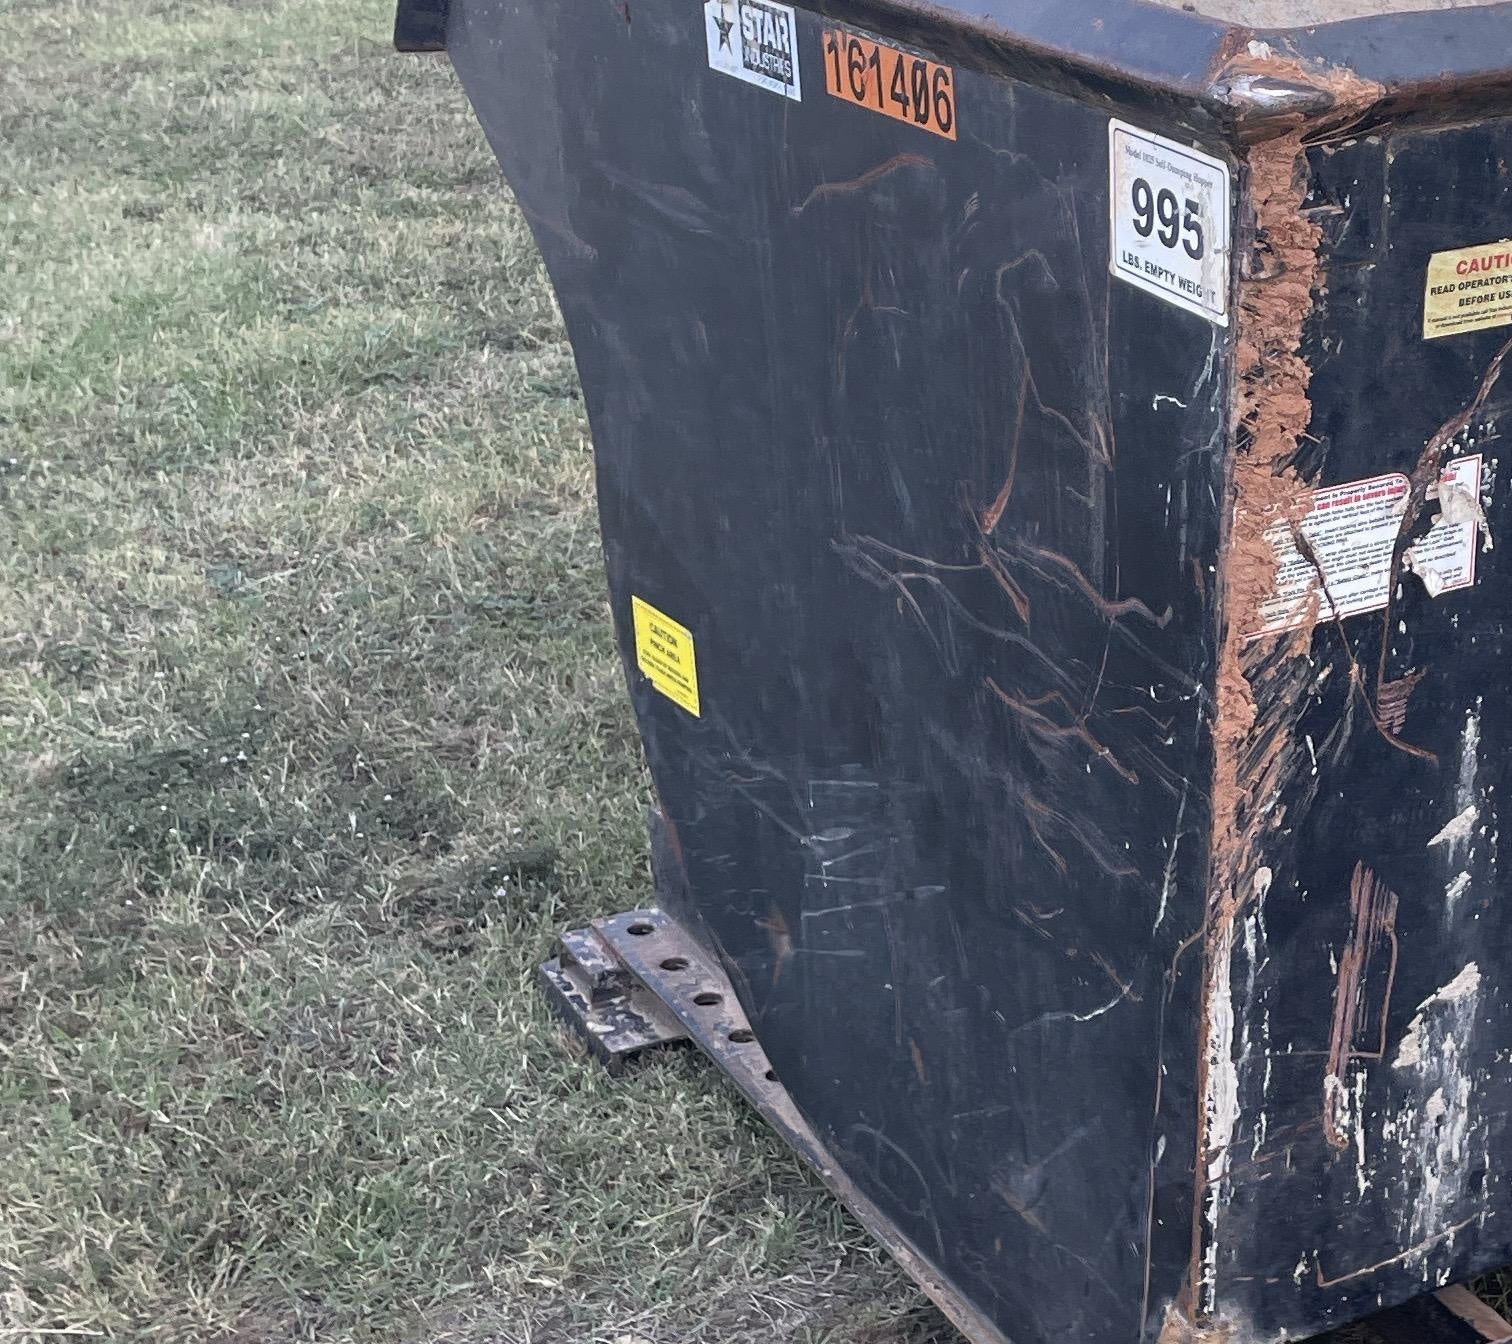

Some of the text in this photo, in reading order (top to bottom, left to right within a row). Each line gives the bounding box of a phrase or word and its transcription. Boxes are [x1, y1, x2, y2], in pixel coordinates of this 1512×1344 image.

[741, 4, 791, 54] STAR
[1131, 177, 1205, 261] 995
[1122, 250, 1143, 271] LBS.
[1144, 258, 1176, 284] EMPTY
[1430, 283, 1456, 296] READ
[1458, 291, 1496, 308] BEFORE
